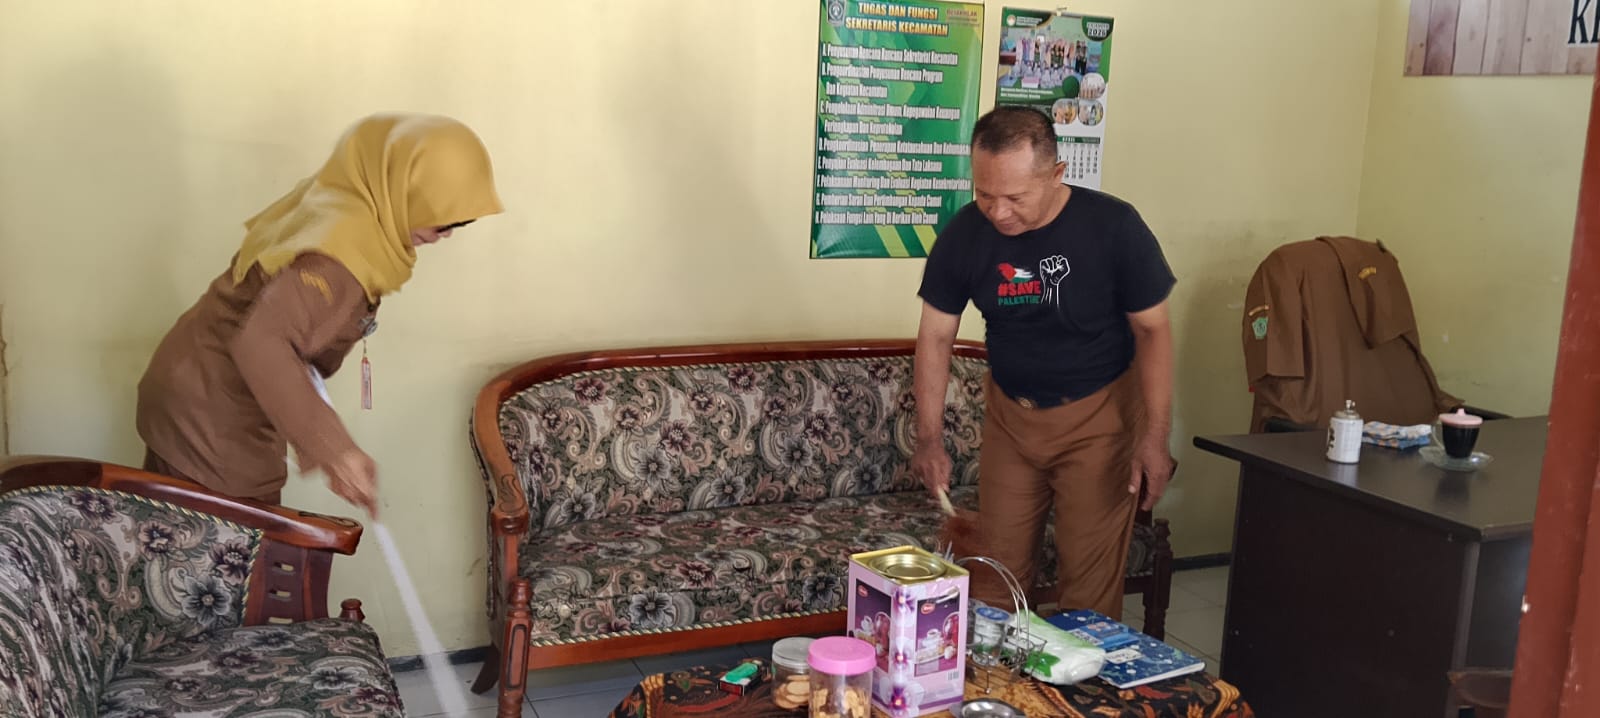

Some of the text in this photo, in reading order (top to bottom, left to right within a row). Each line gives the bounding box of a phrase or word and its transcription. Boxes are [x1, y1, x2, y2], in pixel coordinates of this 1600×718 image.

[858, 2, 938, 20] TUGAS DAN FUNGSI
[845, 17, 949, 36] SEKRETARIS KECAMATAN
[903, 48, 930, 63] Sekretariat
[930, 50, 958, 64] Kecamatan
[922, 68, 943, 83] Program
[836, 82, 858, 97] Kegiatan
[859, 84, 888, 98] Kecamatan
[847, 157, 868, 170] Evaluasi
[912, 159, 922, 172] Tata
[922, 160, 942, 172] Laksana
[853, 176, 880, 189] Monitoring
[890, 176, 911, 189] Evaluasi
[821, 193, 849, 206] Pemberian
[849, 194, 864, 206] Saran
[874, 194, 908, 208] Pertimbangan
[908, 194, 926, 208] Kepada
[927, 194, 942, 208] Camat
[847, 212, 863, 225] Fungsi
[863, 212, 874, 224] Lain
[874, 212, 886, 225] Yang
[911, 212, 923, 224] Oleh
[923, 212, 938, 224] Camat
[998, 280, 1041, 296] #SAVE
